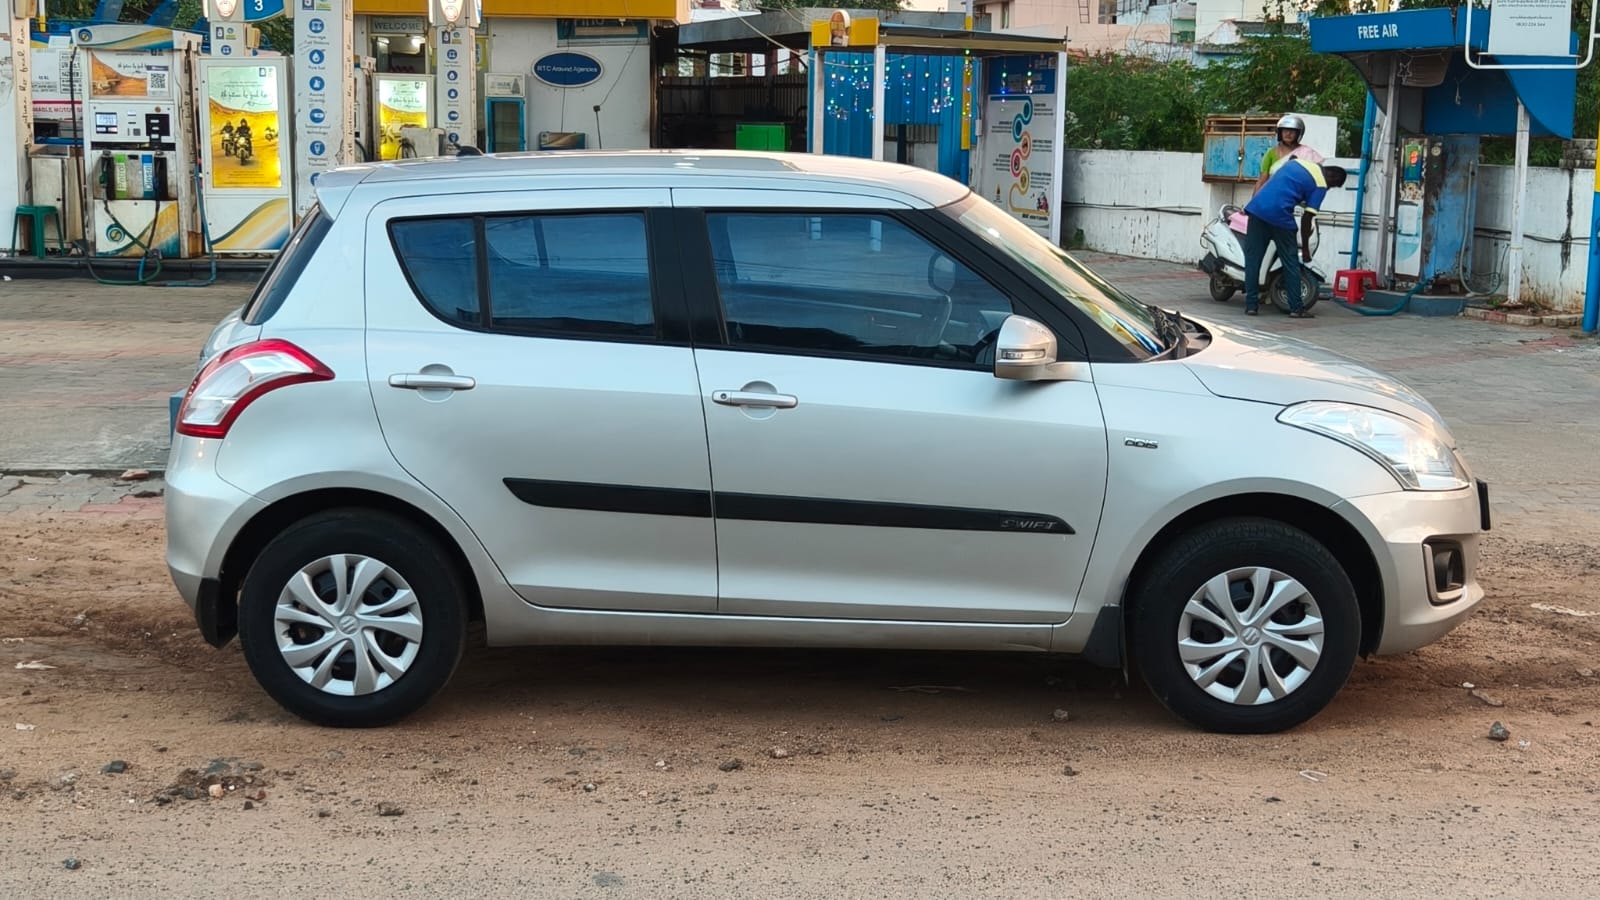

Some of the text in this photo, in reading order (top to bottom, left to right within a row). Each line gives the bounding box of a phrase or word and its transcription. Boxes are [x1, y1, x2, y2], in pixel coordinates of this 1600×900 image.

[254, 0, 264, 11] 3
[375, 22, 420, 31] WELCOME
[1357, 23, 1399, 39] FREE AIR
[573, 66, 598, 74] Agencies
[144, 165, 153, 190] Diesel
[1001, 520, 1057, 529] SWIFT
